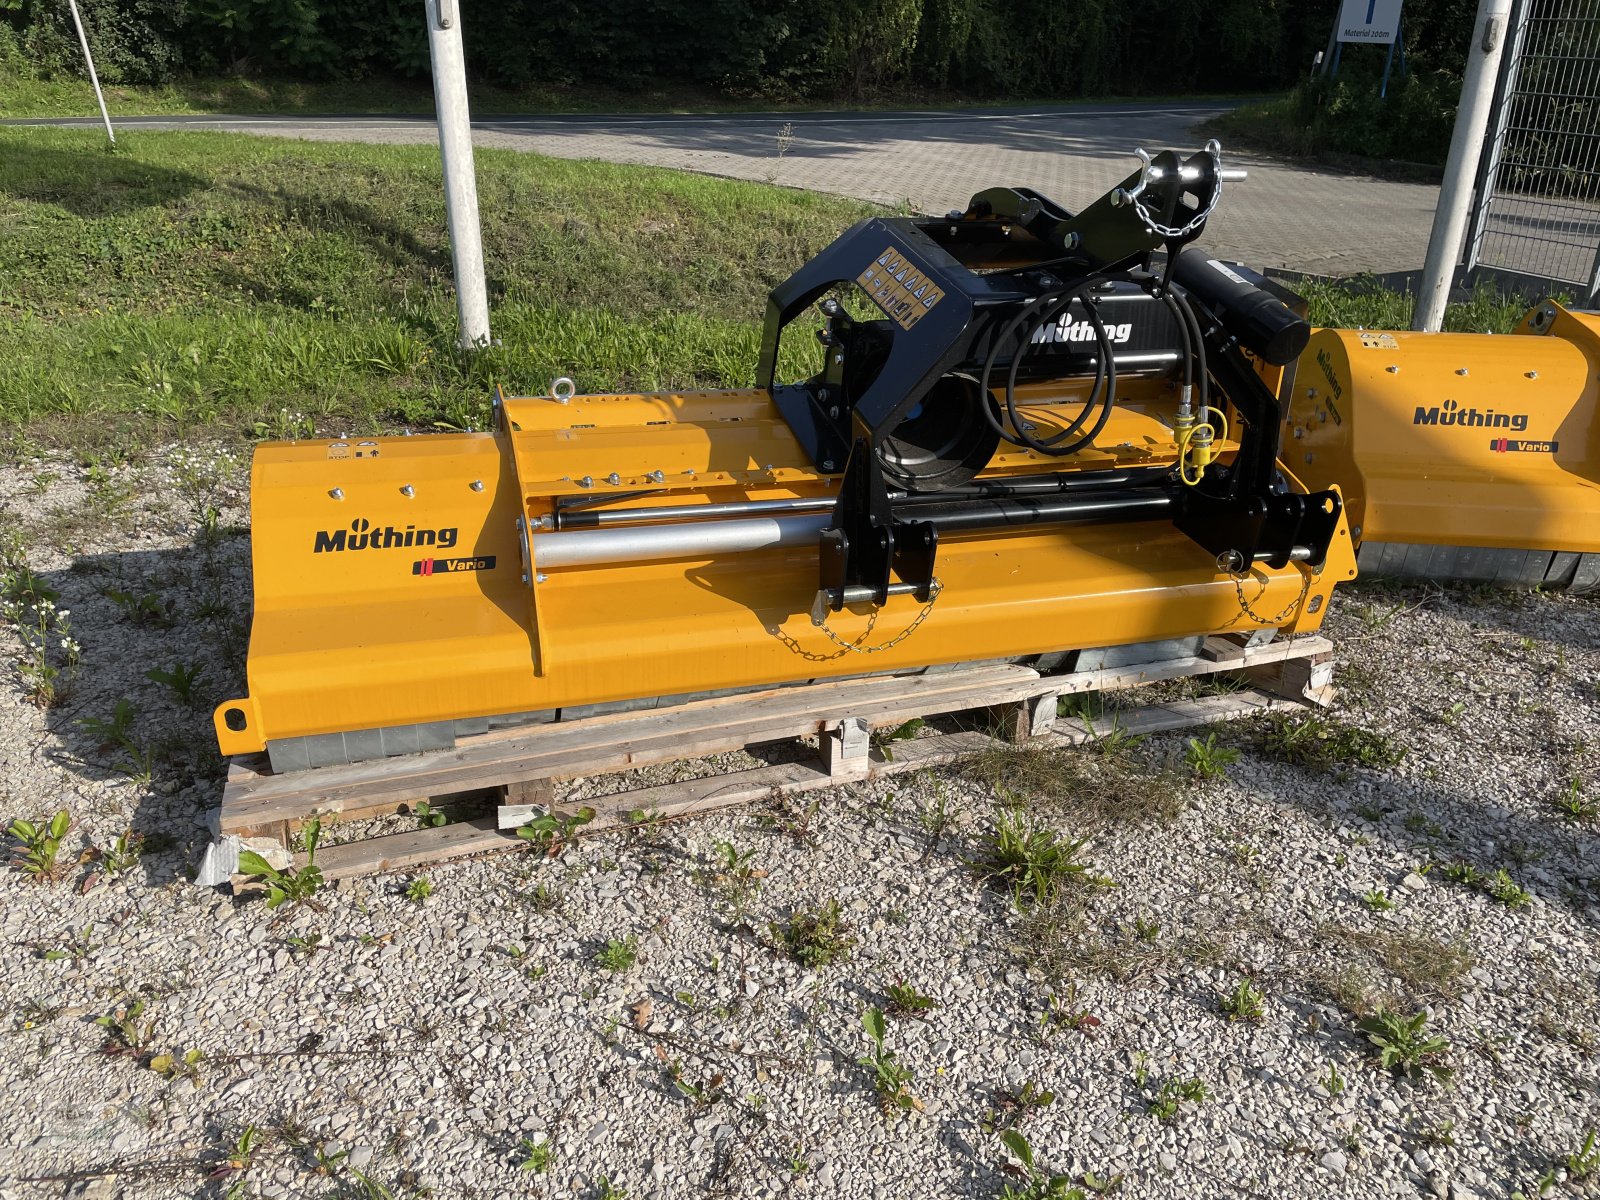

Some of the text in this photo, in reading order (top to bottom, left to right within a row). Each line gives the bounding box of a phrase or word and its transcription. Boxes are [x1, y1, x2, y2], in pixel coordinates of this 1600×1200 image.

[1343, 29, 1390, 38] Material 200m
[1030, 312, 1133, 344] Müthng
[1413, 399, 1529, 432] Müthing
[1517, 441, 1551, 453] Vario
[313, 518, 459, 554] Müthing
[446, 558, 487, 572] Vario
